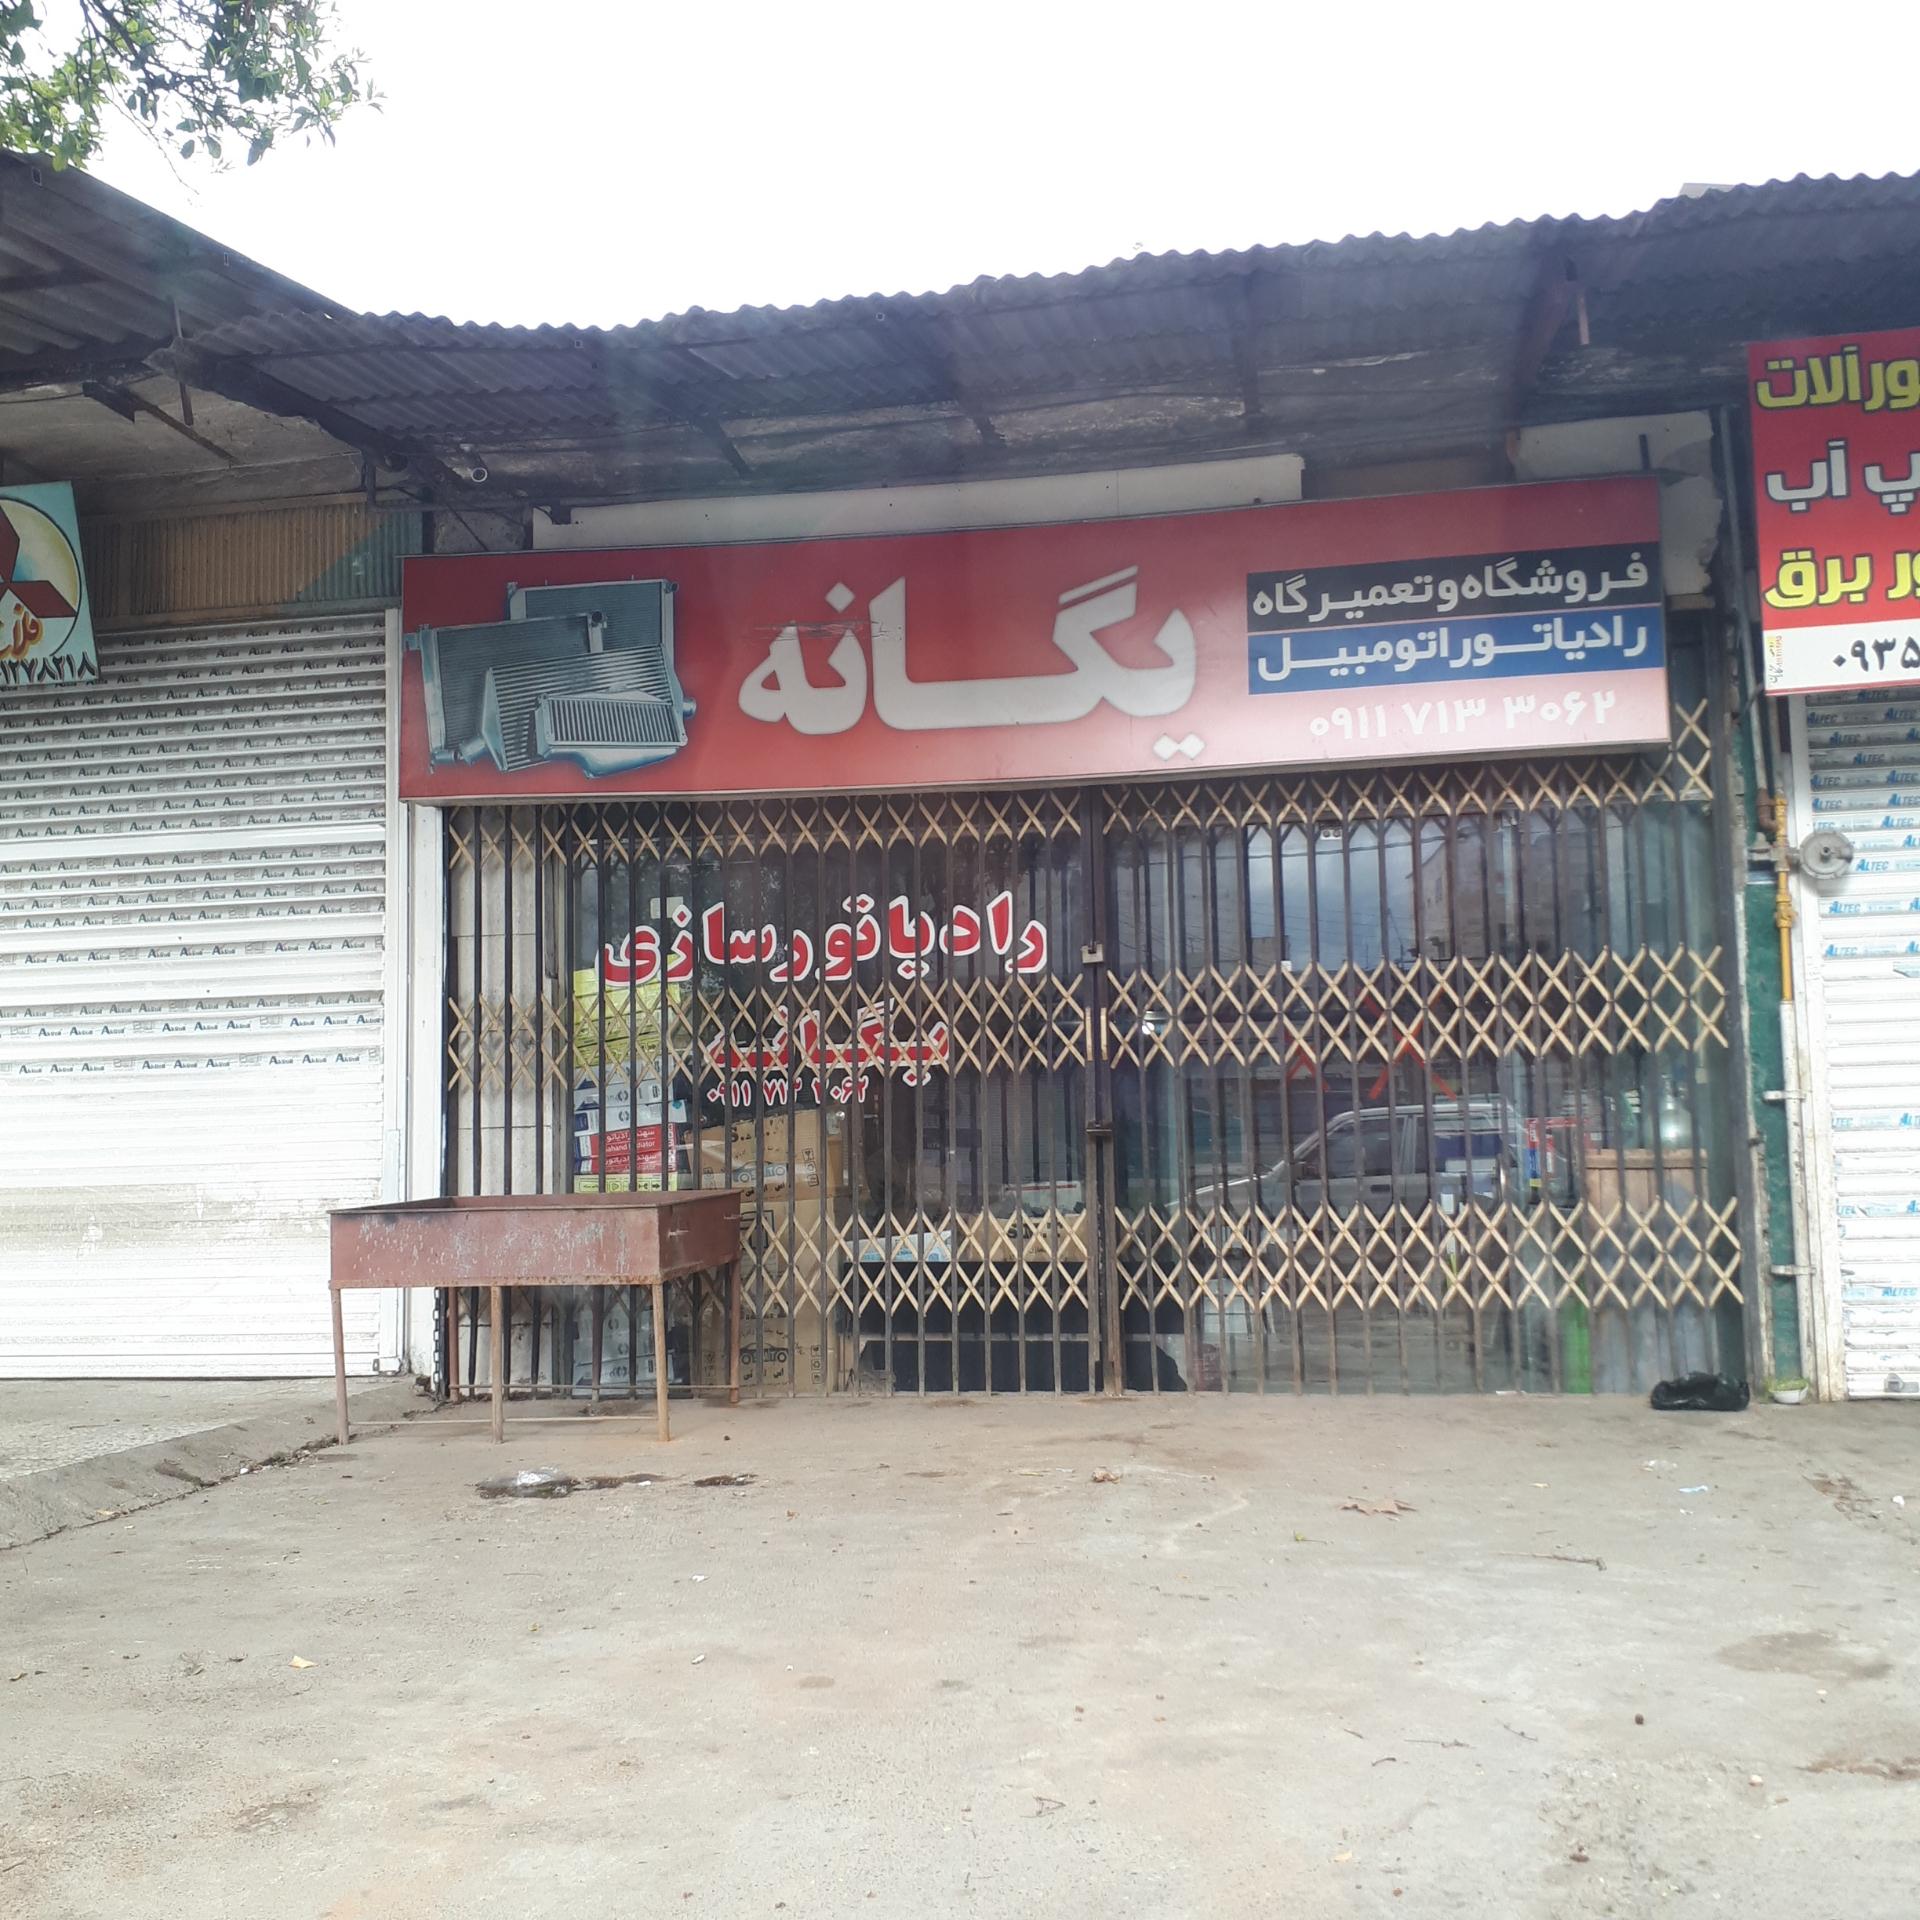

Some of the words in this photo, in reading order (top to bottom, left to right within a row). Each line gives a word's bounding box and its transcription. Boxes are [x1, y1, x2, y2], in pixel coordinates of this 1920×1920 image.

[1766, 439, 1847, 511] آب
[1764, 550, 1872, 608] برق
[738, 565, 1206, 761] یگانه
[1310, 703, 1387, 740] ۰۹۱۱
[1402, 696, 1486, 736] ۷۱۳
[1503, 689, 1617, 728] ۳۰۶۲
[1856, 859, 1889, 872] ALTEC
